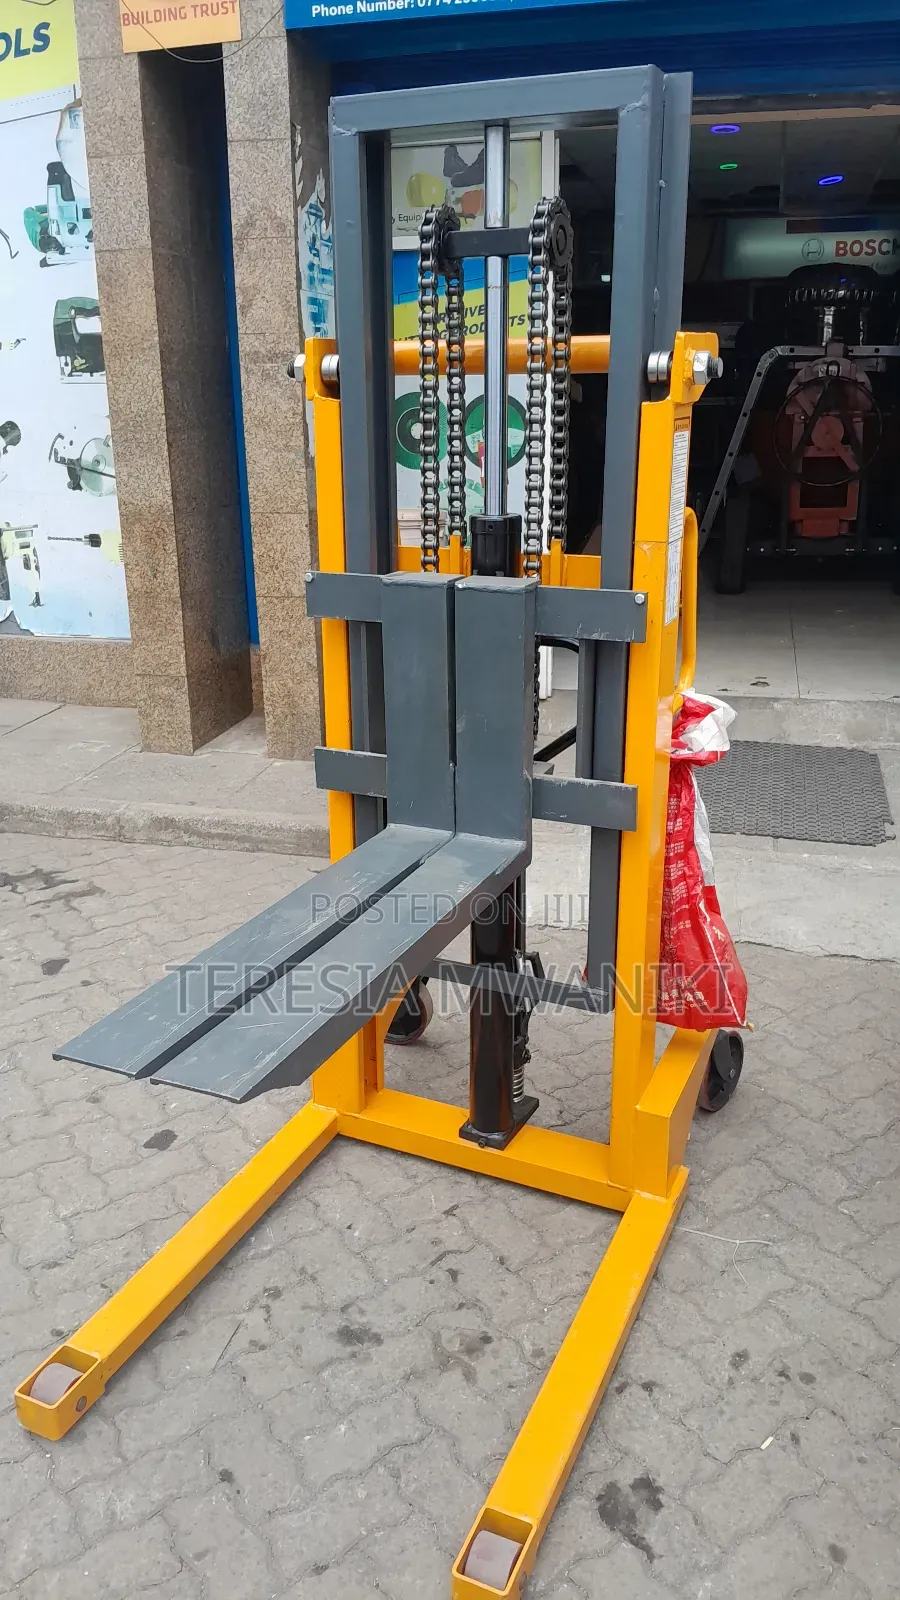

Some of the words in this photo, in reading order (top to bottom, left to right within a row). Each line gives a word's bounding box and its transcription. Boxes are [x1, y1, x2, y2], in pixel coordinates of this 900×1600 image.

[122, 6, 188, 27] BUILDING
[190, 0, 238, 19] TRUST
[311, 4, 354, 18] Phone
[356, 0, 415, 14] Number:
